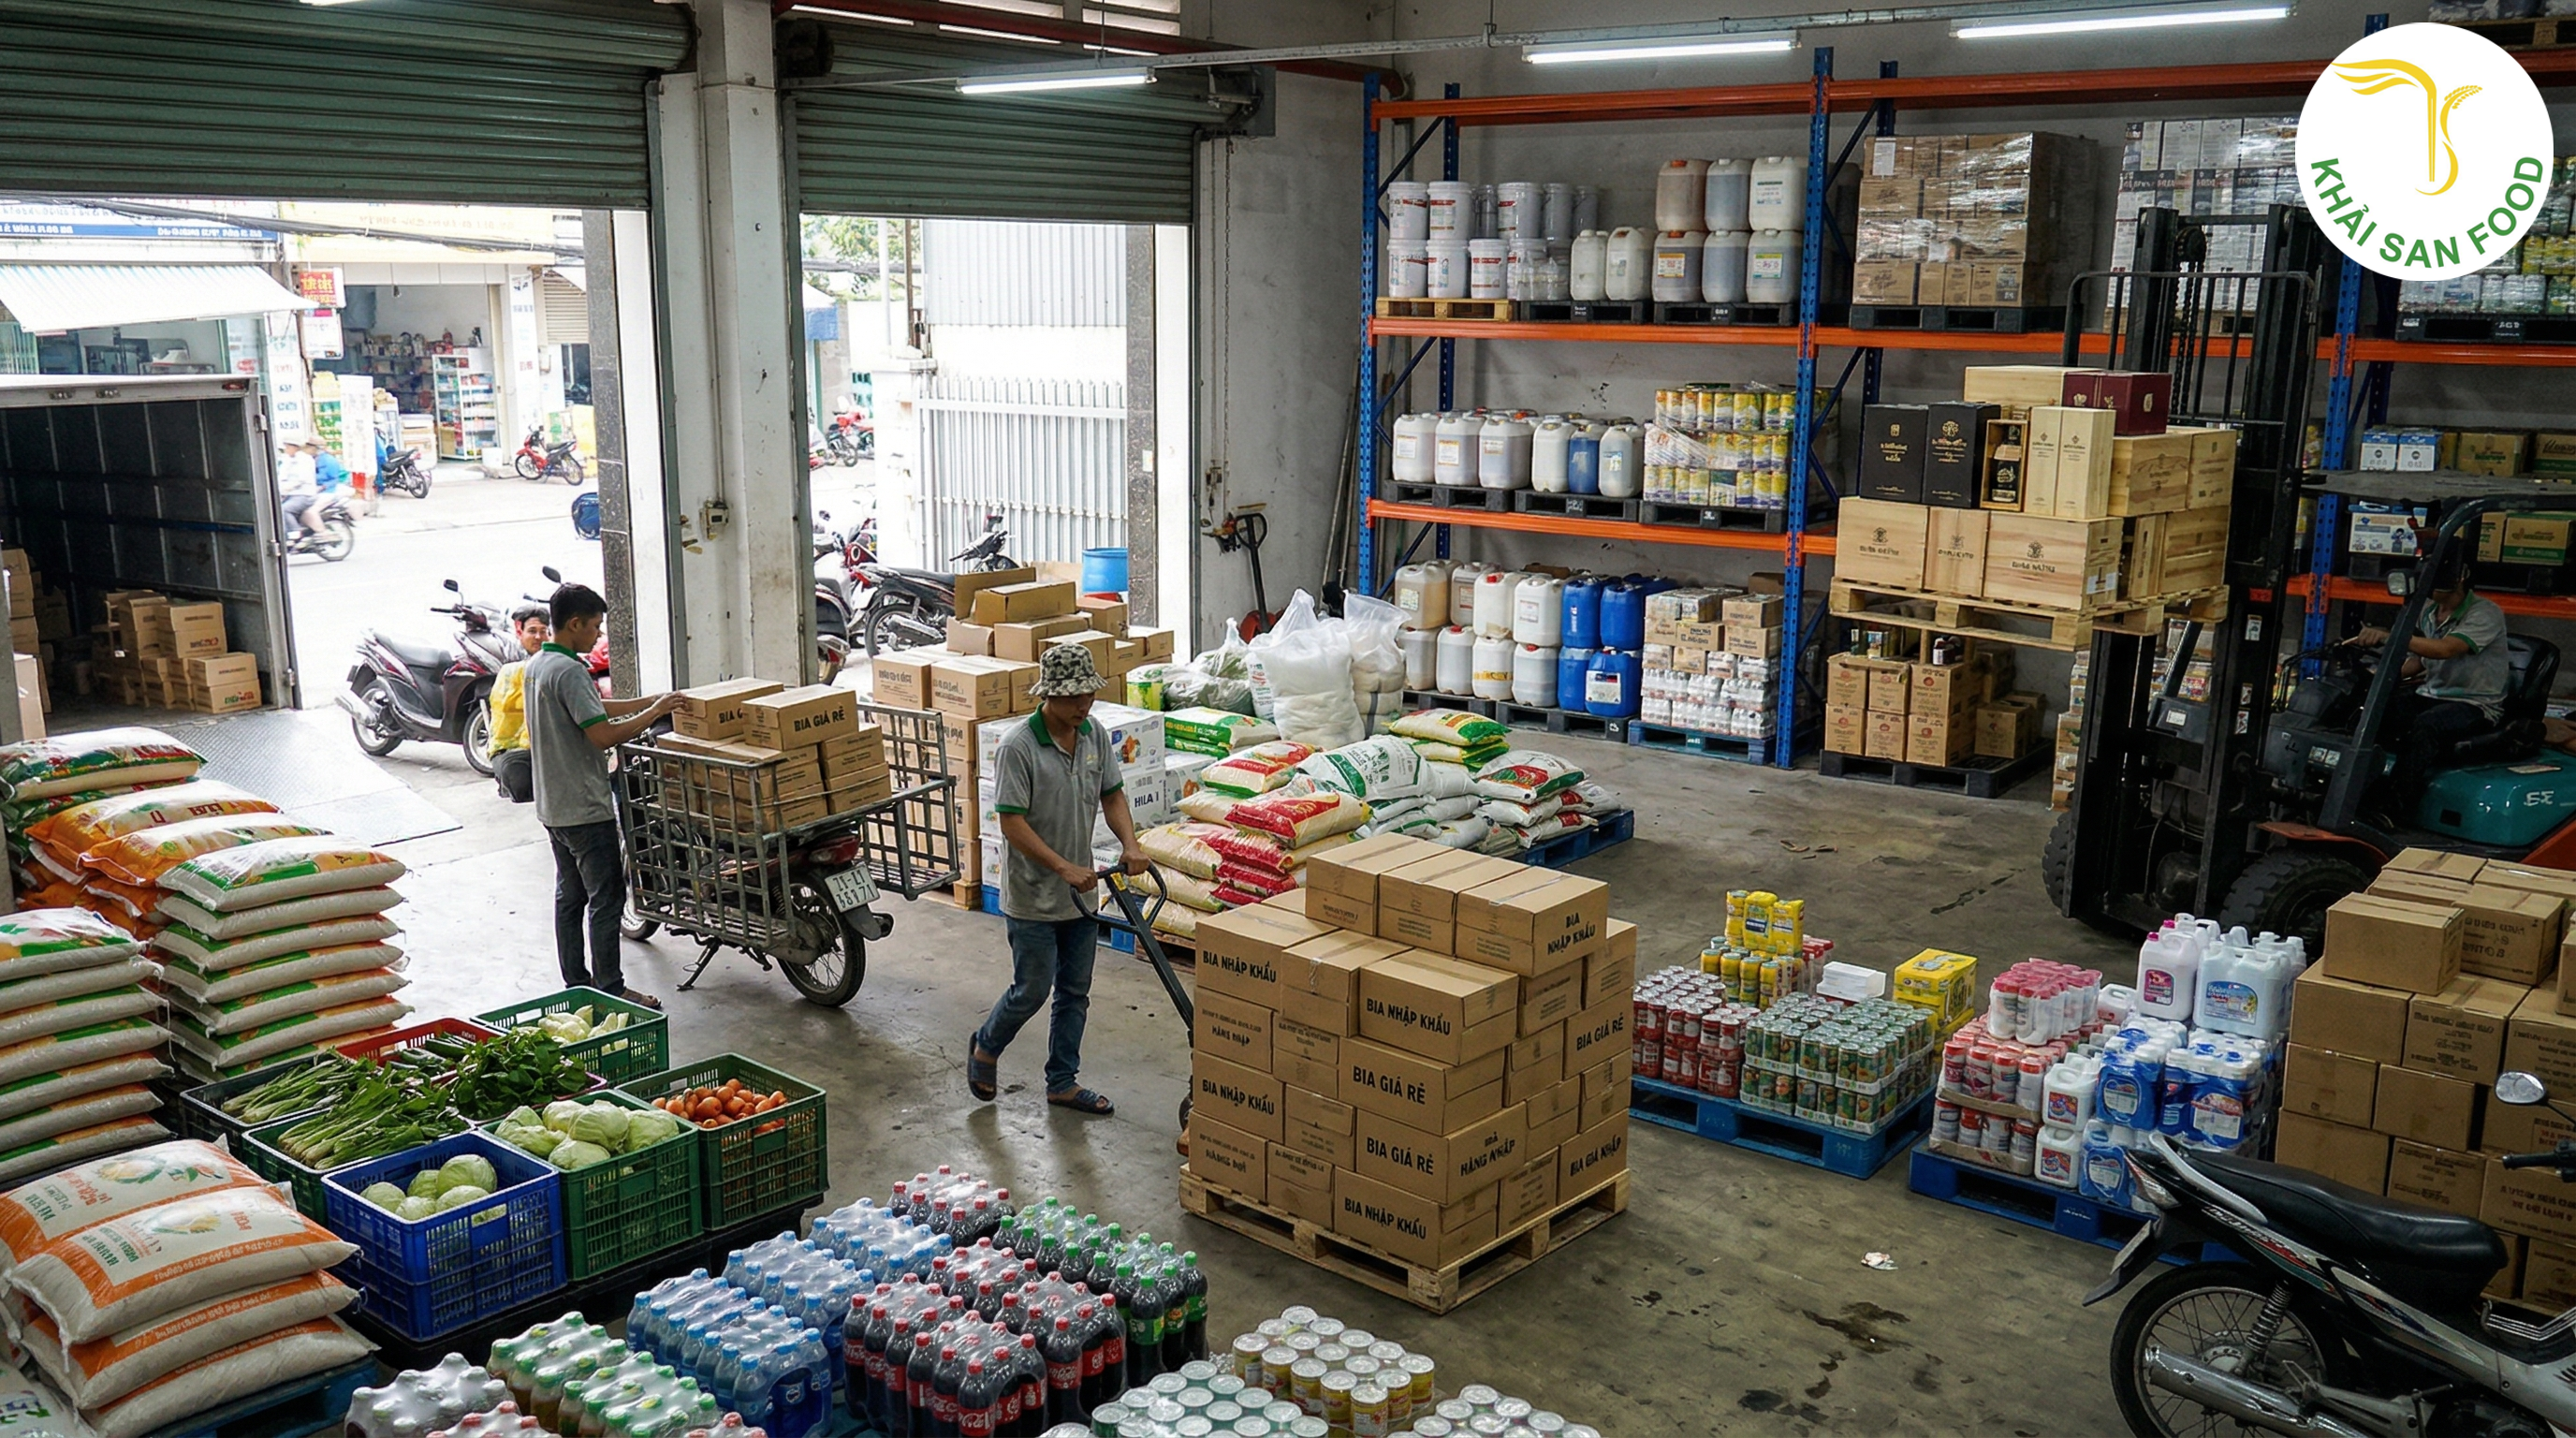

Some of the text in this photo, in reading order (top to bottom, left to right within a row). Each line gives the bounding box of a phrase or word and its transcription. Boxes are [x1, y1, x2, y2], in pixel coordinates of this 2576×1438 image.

[794, 718, 812, 732] BIA
[813, 711, 830, 727] GIÁ
[1566, 913, 1579, 928] BIA
[1203, 950, 1219, 967] BIA
[1367, 998, 1384, 1016] BIA
[1576, 1032, 1591, 1051] BIA
[1354, 1065, 1376, 1088] BIA
[1380, 1076, 1402, 1097] GIÁ
[1367, 1137, 1387, 1159] BIA
[1391, 1147, 1412, 1167] GIÁ
[1344, 1197, 1362, 1216] BIA
